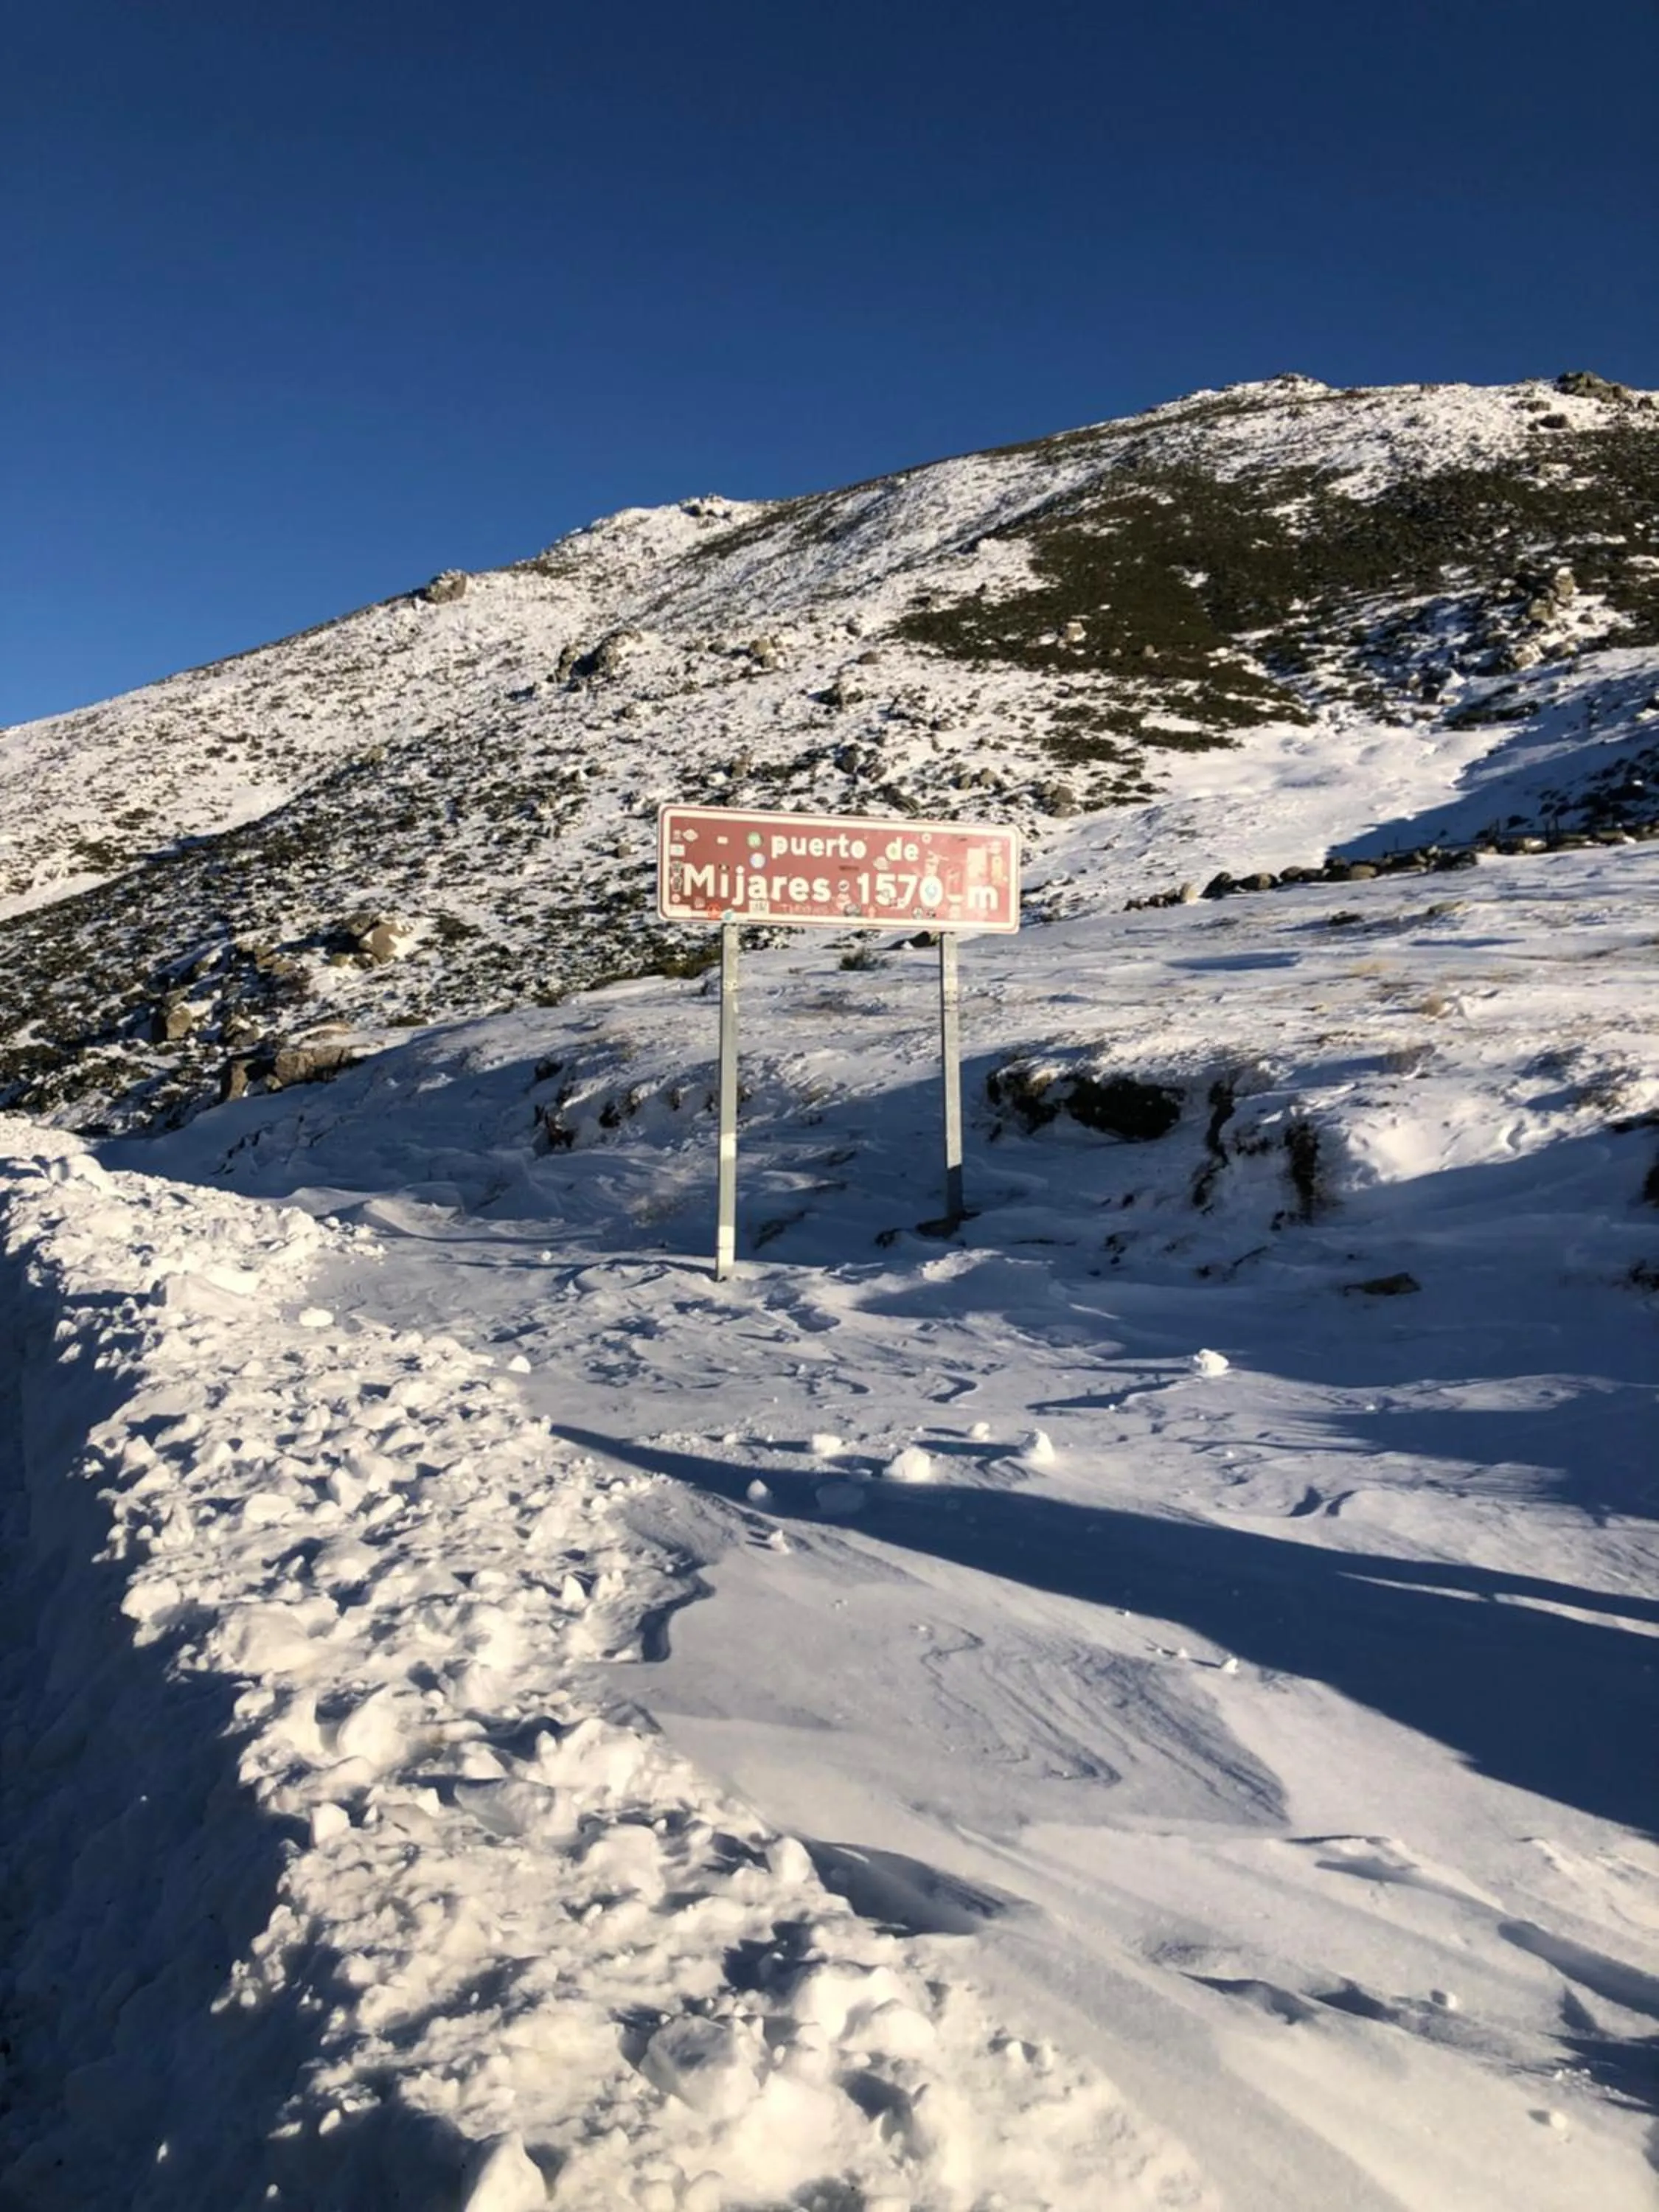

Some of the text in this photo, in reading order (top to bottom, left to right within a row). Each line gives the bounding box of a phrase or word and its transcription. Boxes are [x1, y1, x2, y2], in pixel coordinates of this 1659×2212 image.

[771, 833, 919, 861] puerto de
[683, 862, 998, 911] Mijares 1570 m
